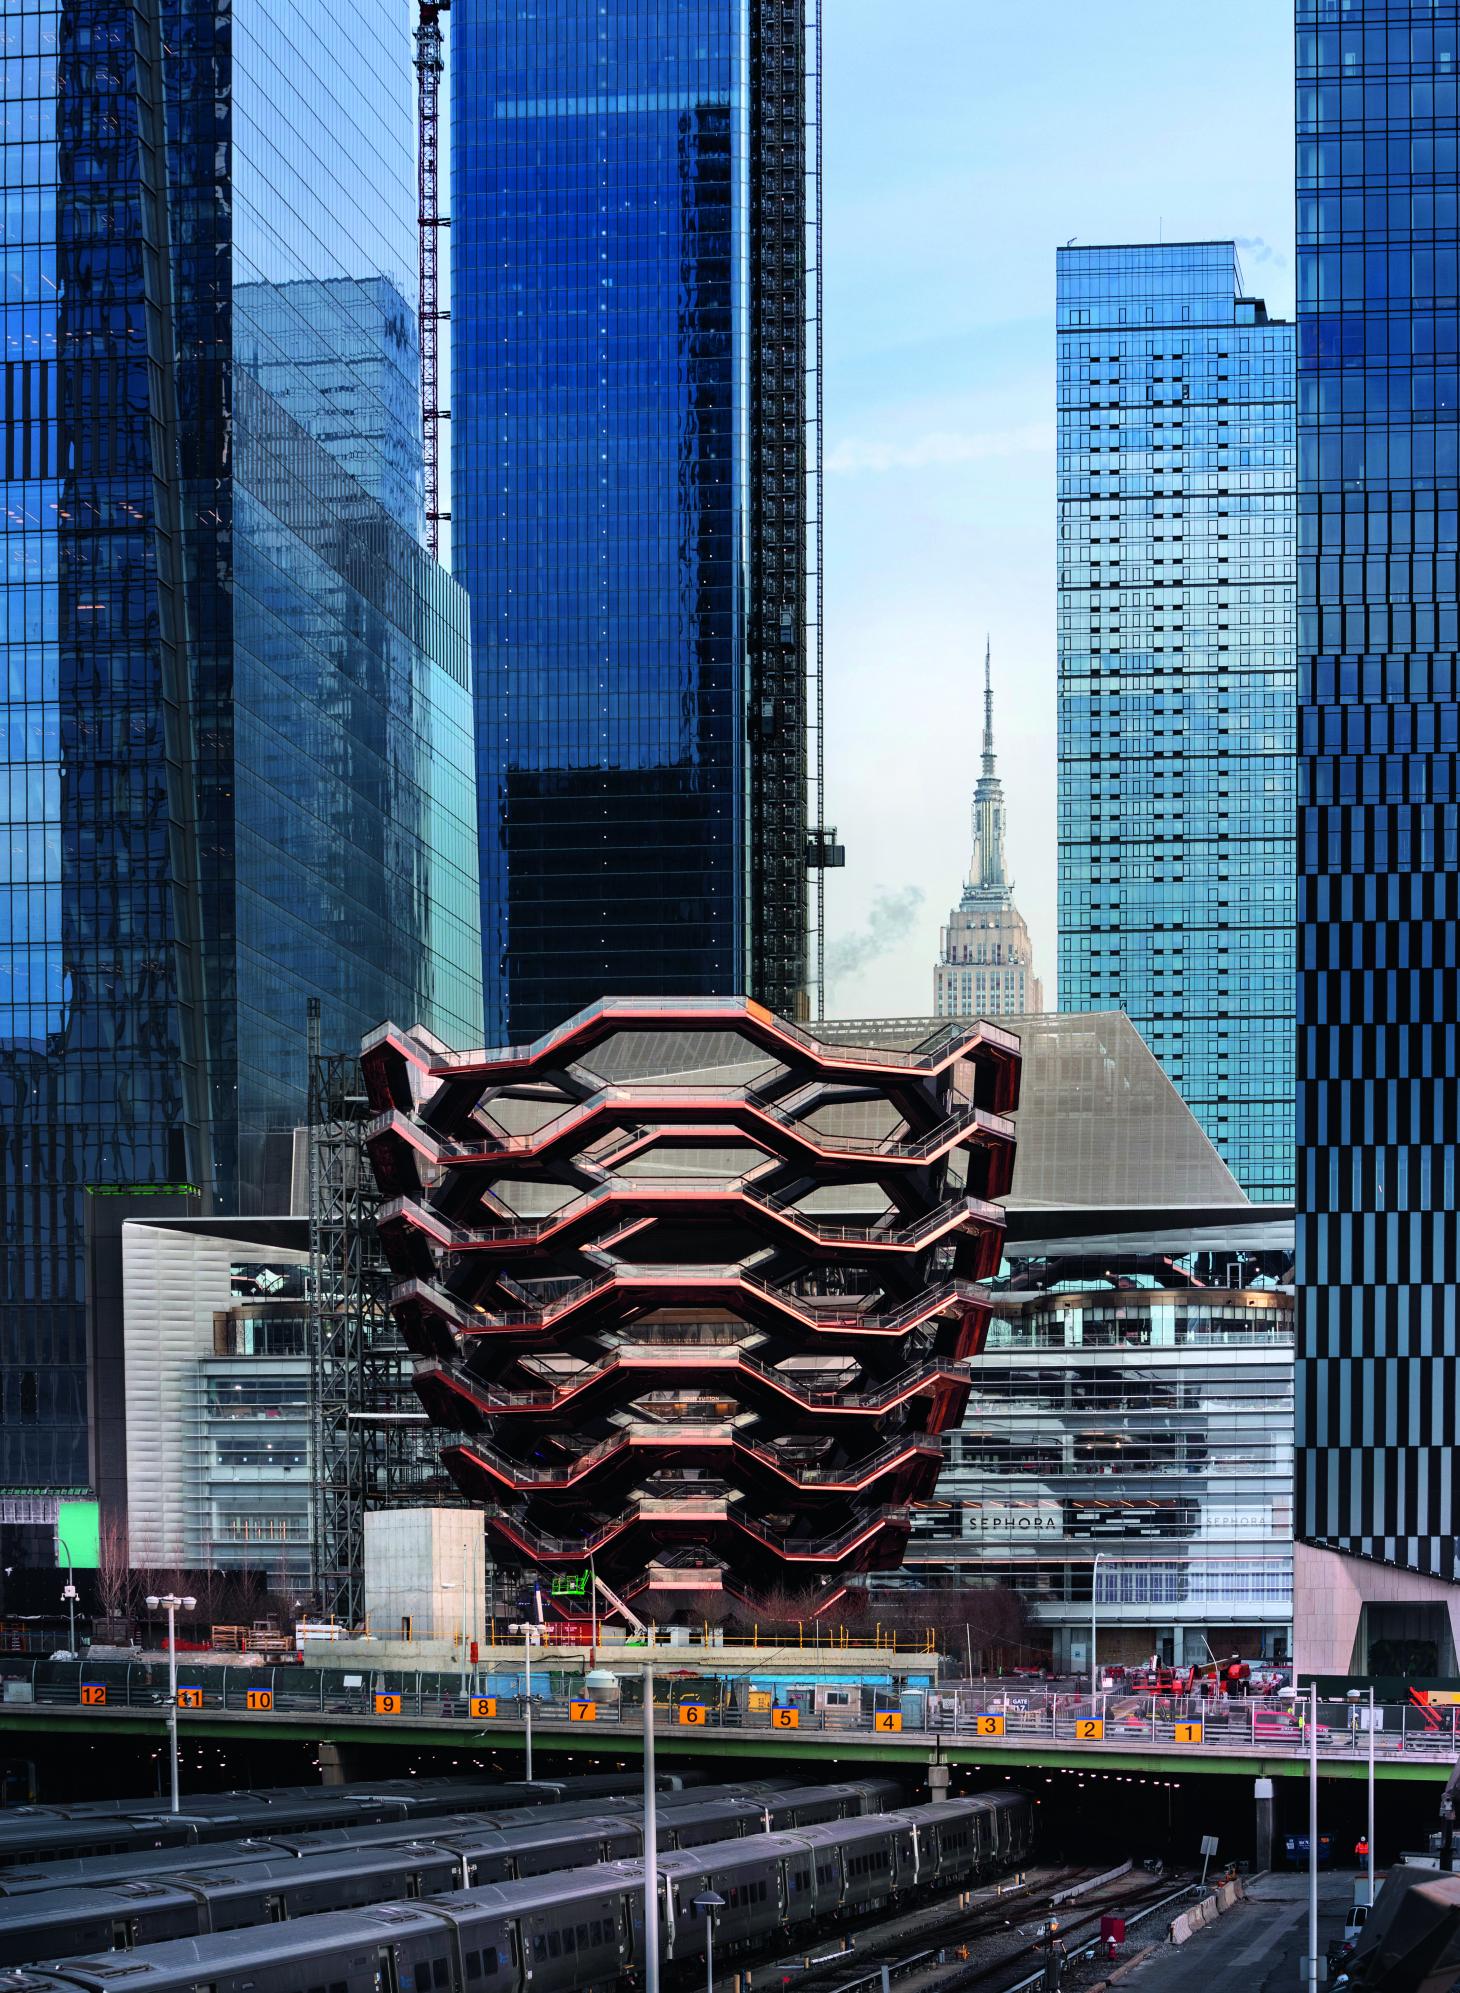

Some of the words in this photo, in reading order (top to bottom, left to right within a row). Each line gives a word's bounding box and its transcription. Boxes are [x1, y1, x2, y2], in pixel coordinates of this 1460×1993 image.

[969, 1517, 1056, 1530] SEPHORA
[1206, 1517, 1265, 1528] SEPHORA
[85, 1688, 103, 1703] 12
[250, 1692, 269, 1707] 10
[383, 1696, 394, 1711] 9
[478, 1699, 489, 1715] 8
[577, 1704, 589, 1719] 7
[686, 1707, 698, 1722] 6
[780, 1710, 791, 1726] 5
[882, 1714, 895, 1730] 4
[984, 1718, 996, 1733] 3
[1084, 1721, 1095, 1737] 2
[1185, 1726, 1192, 1741] 1
